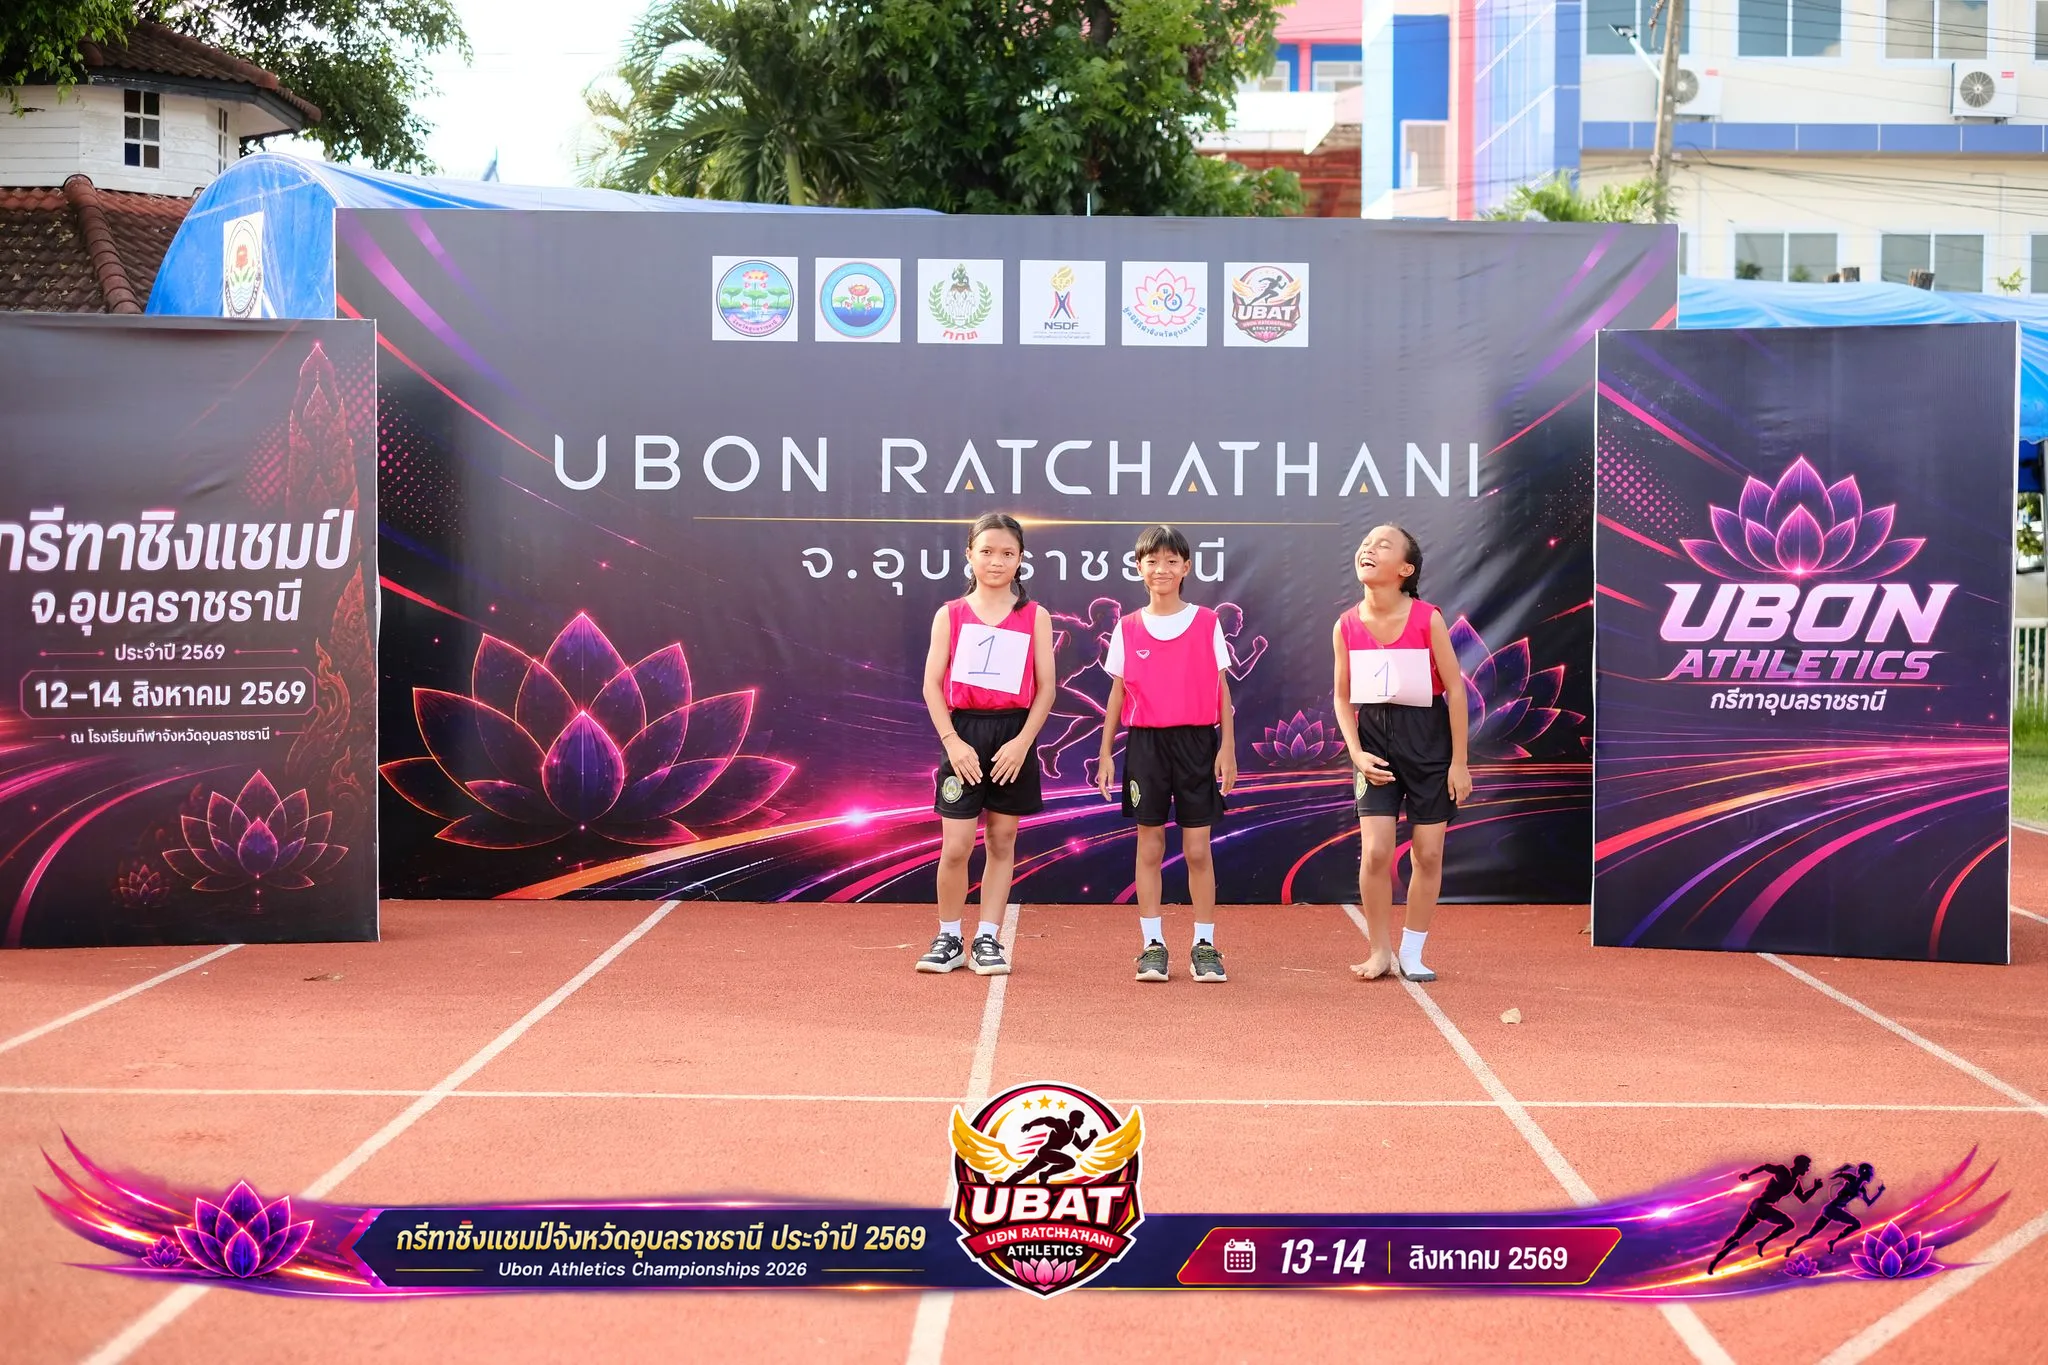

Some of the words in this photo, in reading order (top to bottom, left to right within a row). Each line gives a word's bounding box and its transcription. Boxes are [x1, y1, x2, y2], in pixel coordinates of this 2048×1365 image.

[1044, 321, 1080, 331] NSDF
[1237, 305, 1297, 321] UBAT
[554, 433, 828, 492] UBON
[881, 437, 1479, 498] RATCHATHANI
[31, 578, 303, 636] จ.อุบลราชธานี
[1659, 582, 1960, 643] UBON
[114, 642, 176, 661] ประจำปี
[181, 643, 226, 660] 2569
[967, 635, 1001, 676] 1
[1665, 648, 1937, 681] ATHLETICS
[132, 680, 231, 707] สิงหาคม
[240, 680, 306, 705] 2569
[1374, 661, 1397, 698] 1
[70, 733, 84, 744] ณ
